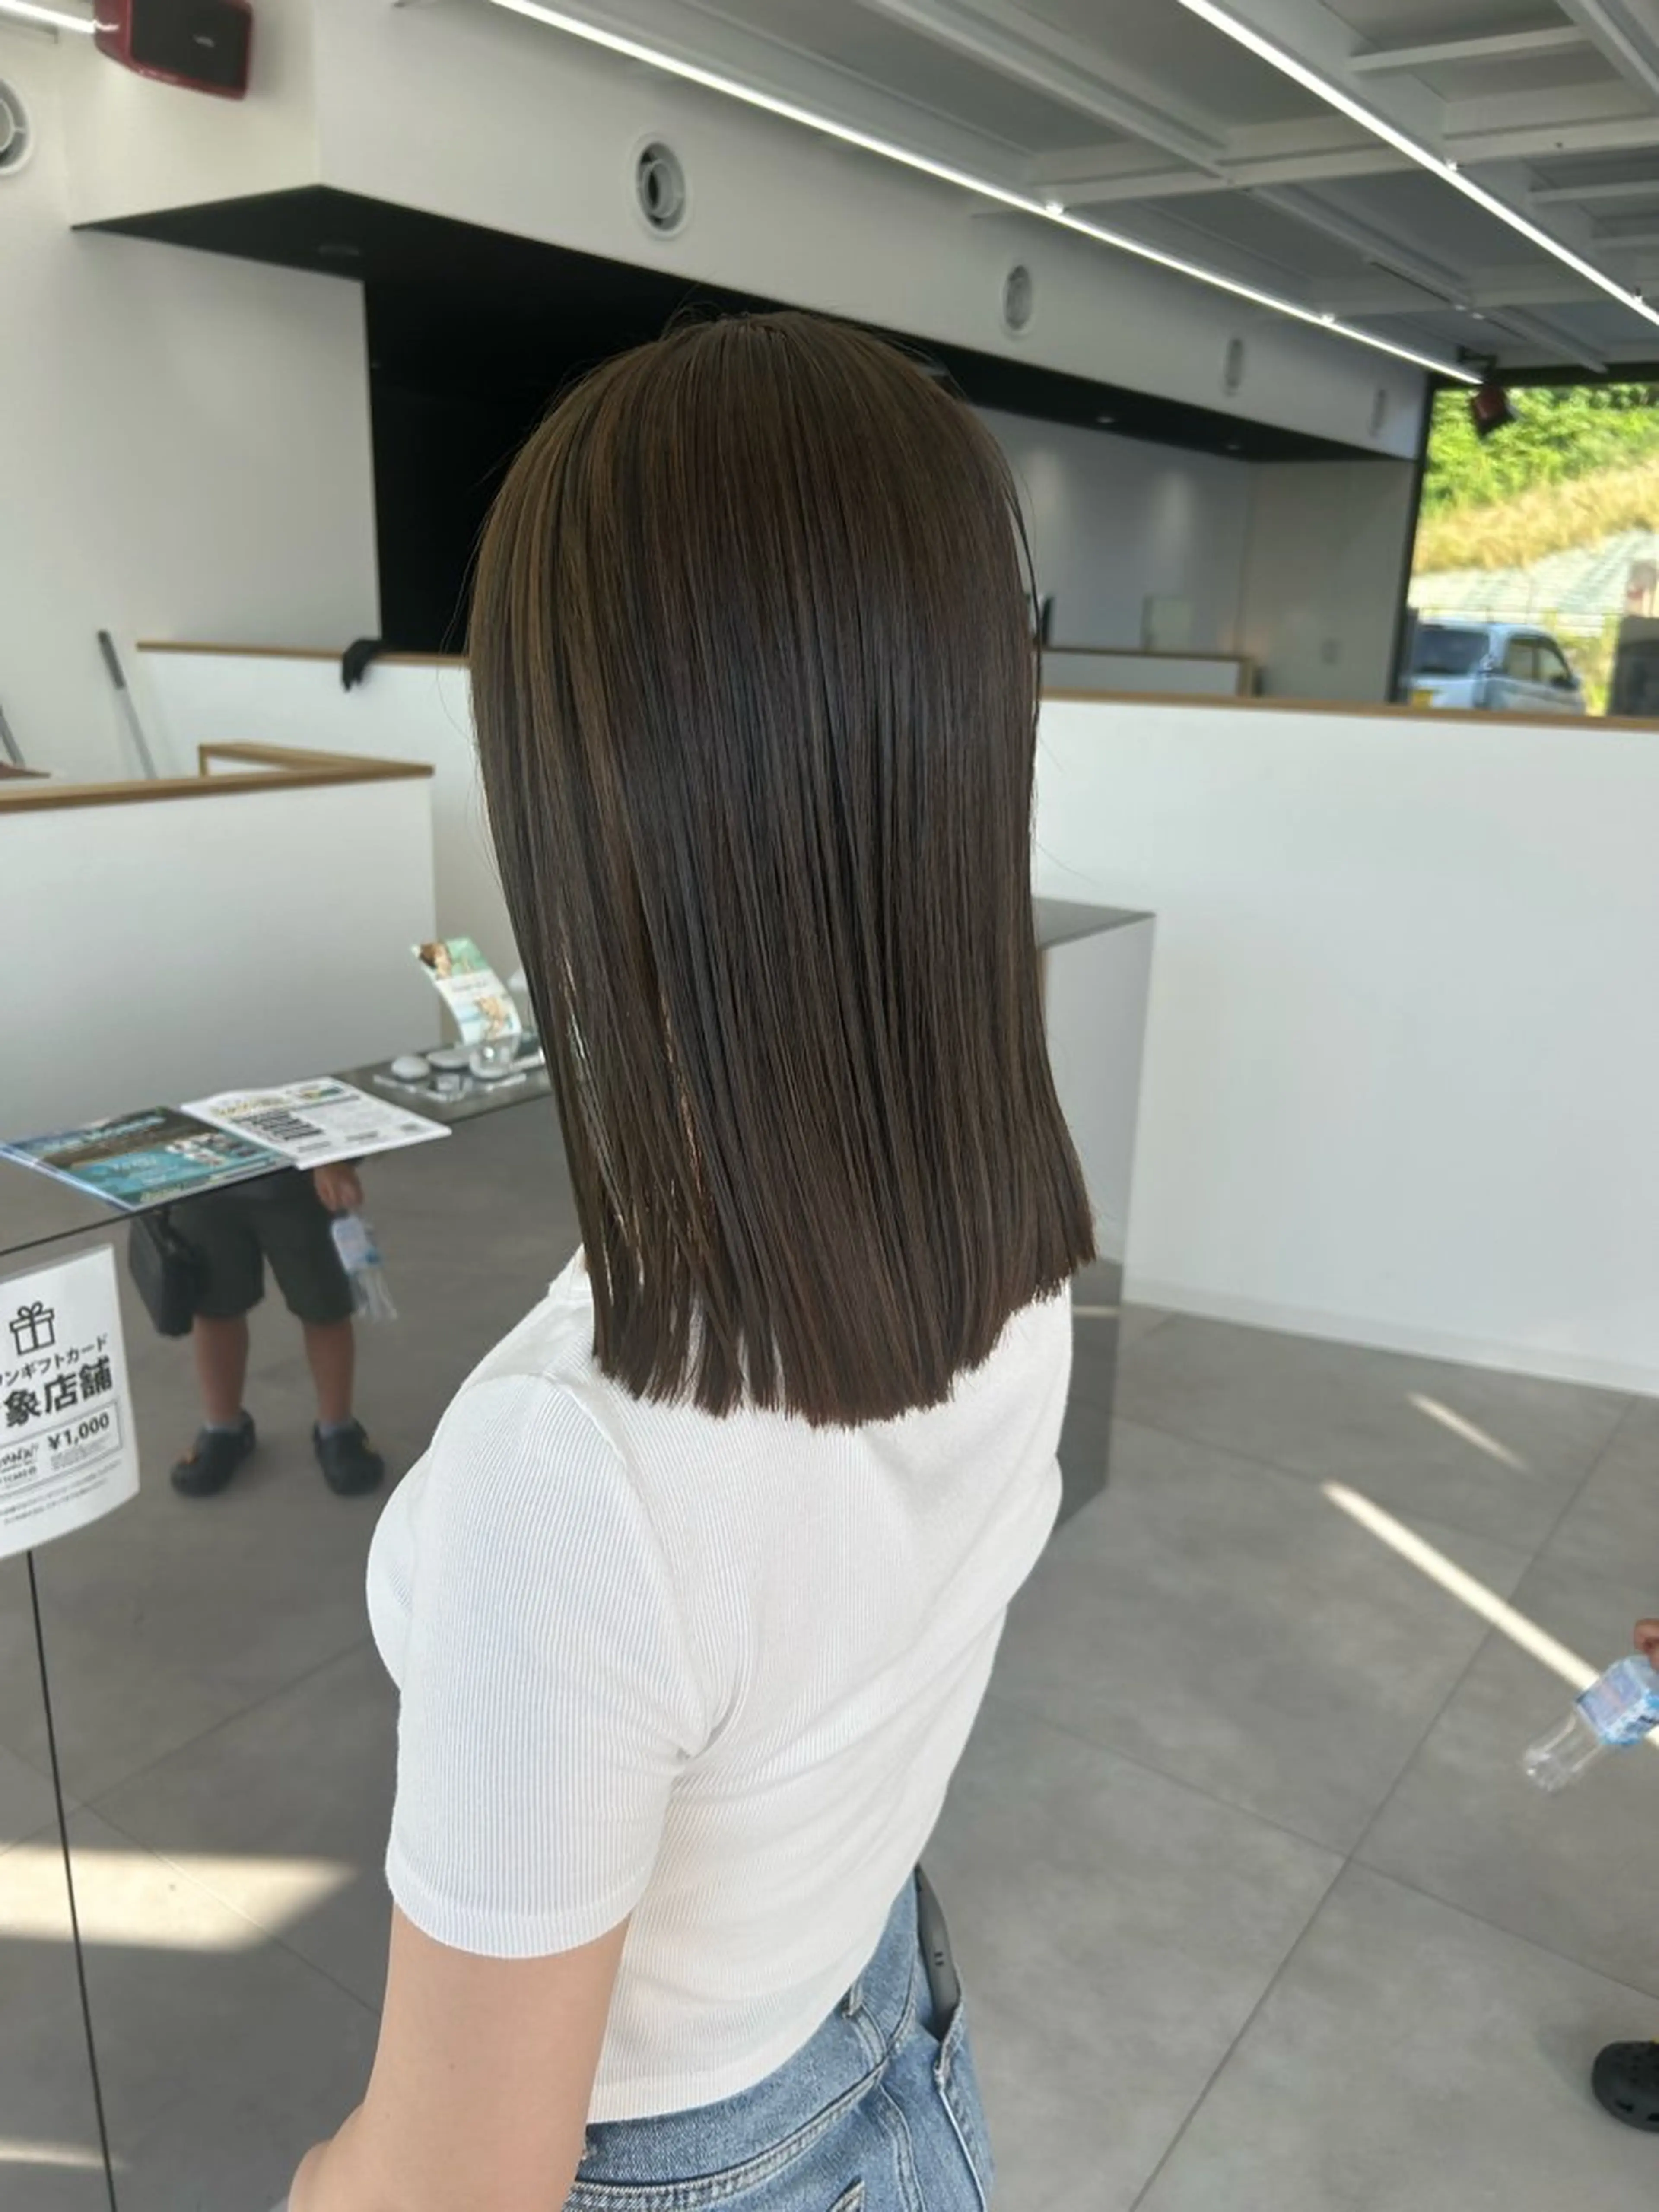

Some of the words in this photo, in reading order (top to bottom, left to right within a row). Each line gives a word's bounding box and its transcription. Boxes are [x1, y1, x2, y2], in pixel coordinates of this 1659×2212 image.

[0, 1333, 108, 1386] ンギフトカード
[48, 1412, 109, 1449] ¥1,000
